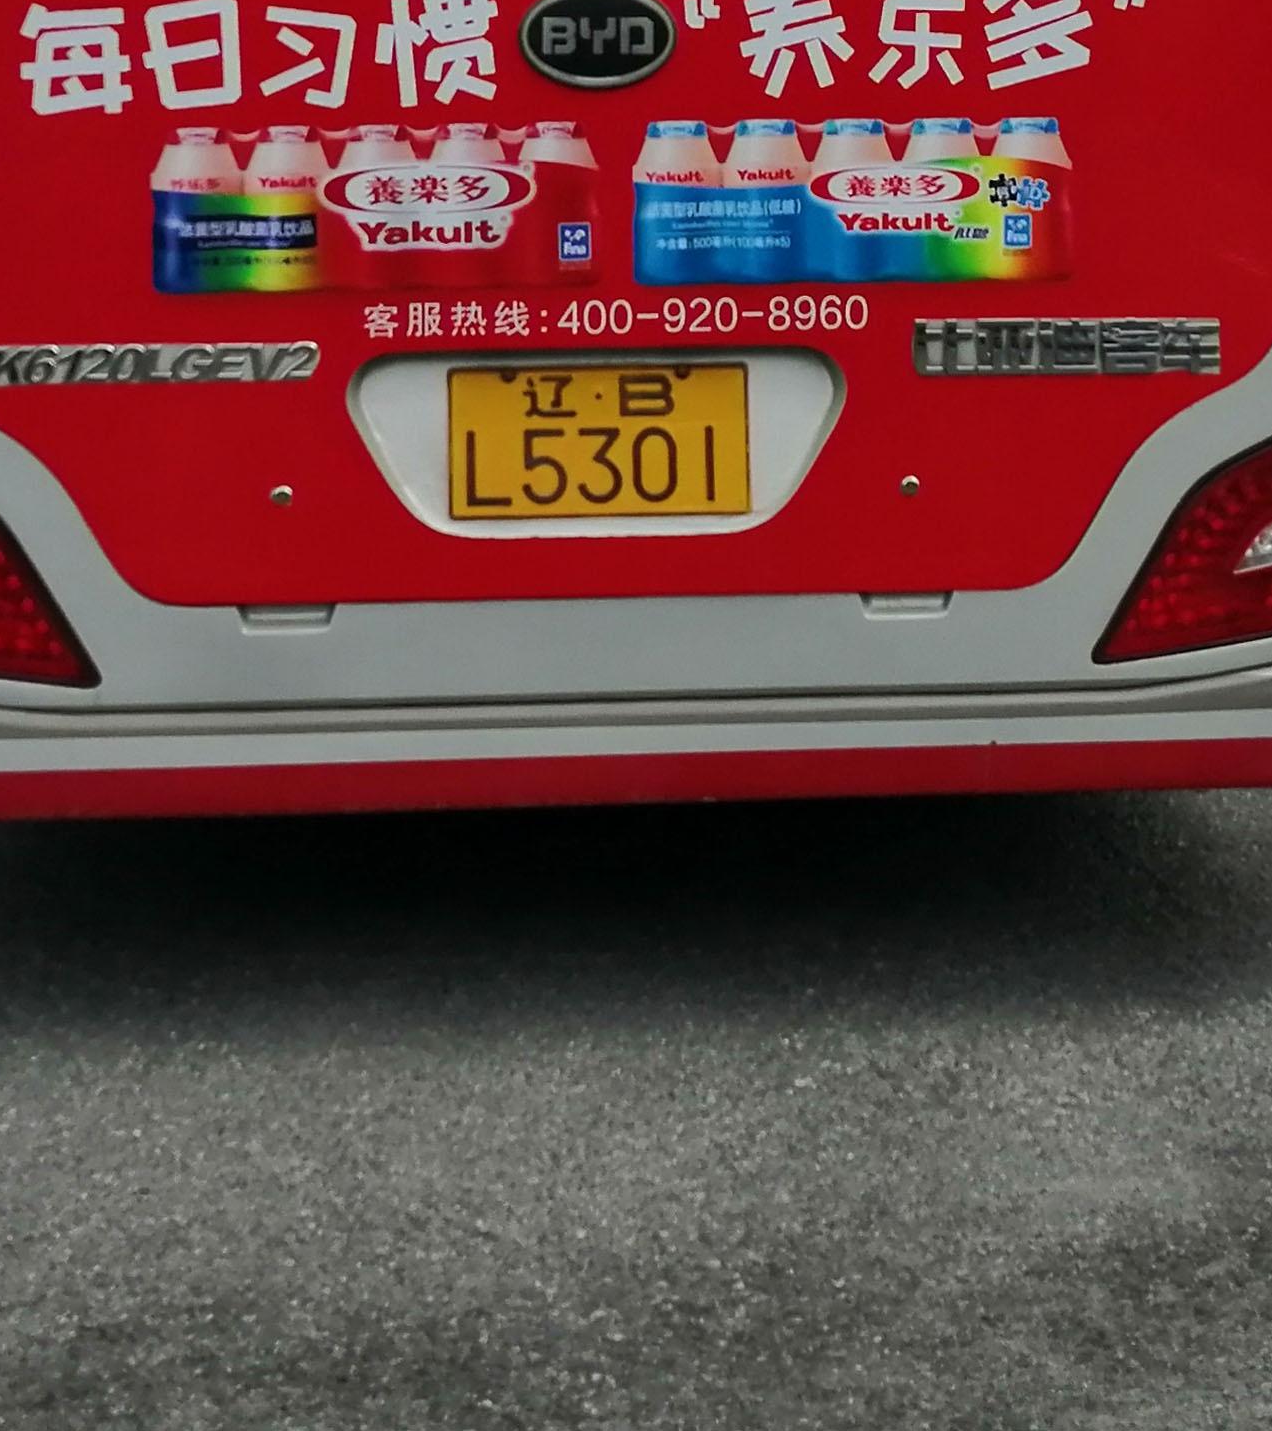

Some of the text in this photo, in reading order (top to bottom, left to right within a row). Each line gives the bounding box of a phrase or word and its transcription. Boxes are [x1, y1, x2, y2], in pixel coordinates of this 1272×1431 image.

[540, 14, 655, 57] BYD
[258, 175, 319, 189] Yakult
[645, 170, 705, 184] Yakult
[737, 168, 797, 182] Yakult
[357, 220, 502, 246] Yakult
[837, 211, 955, 236] Yakult
[465, 424, 717, 508] L5301
